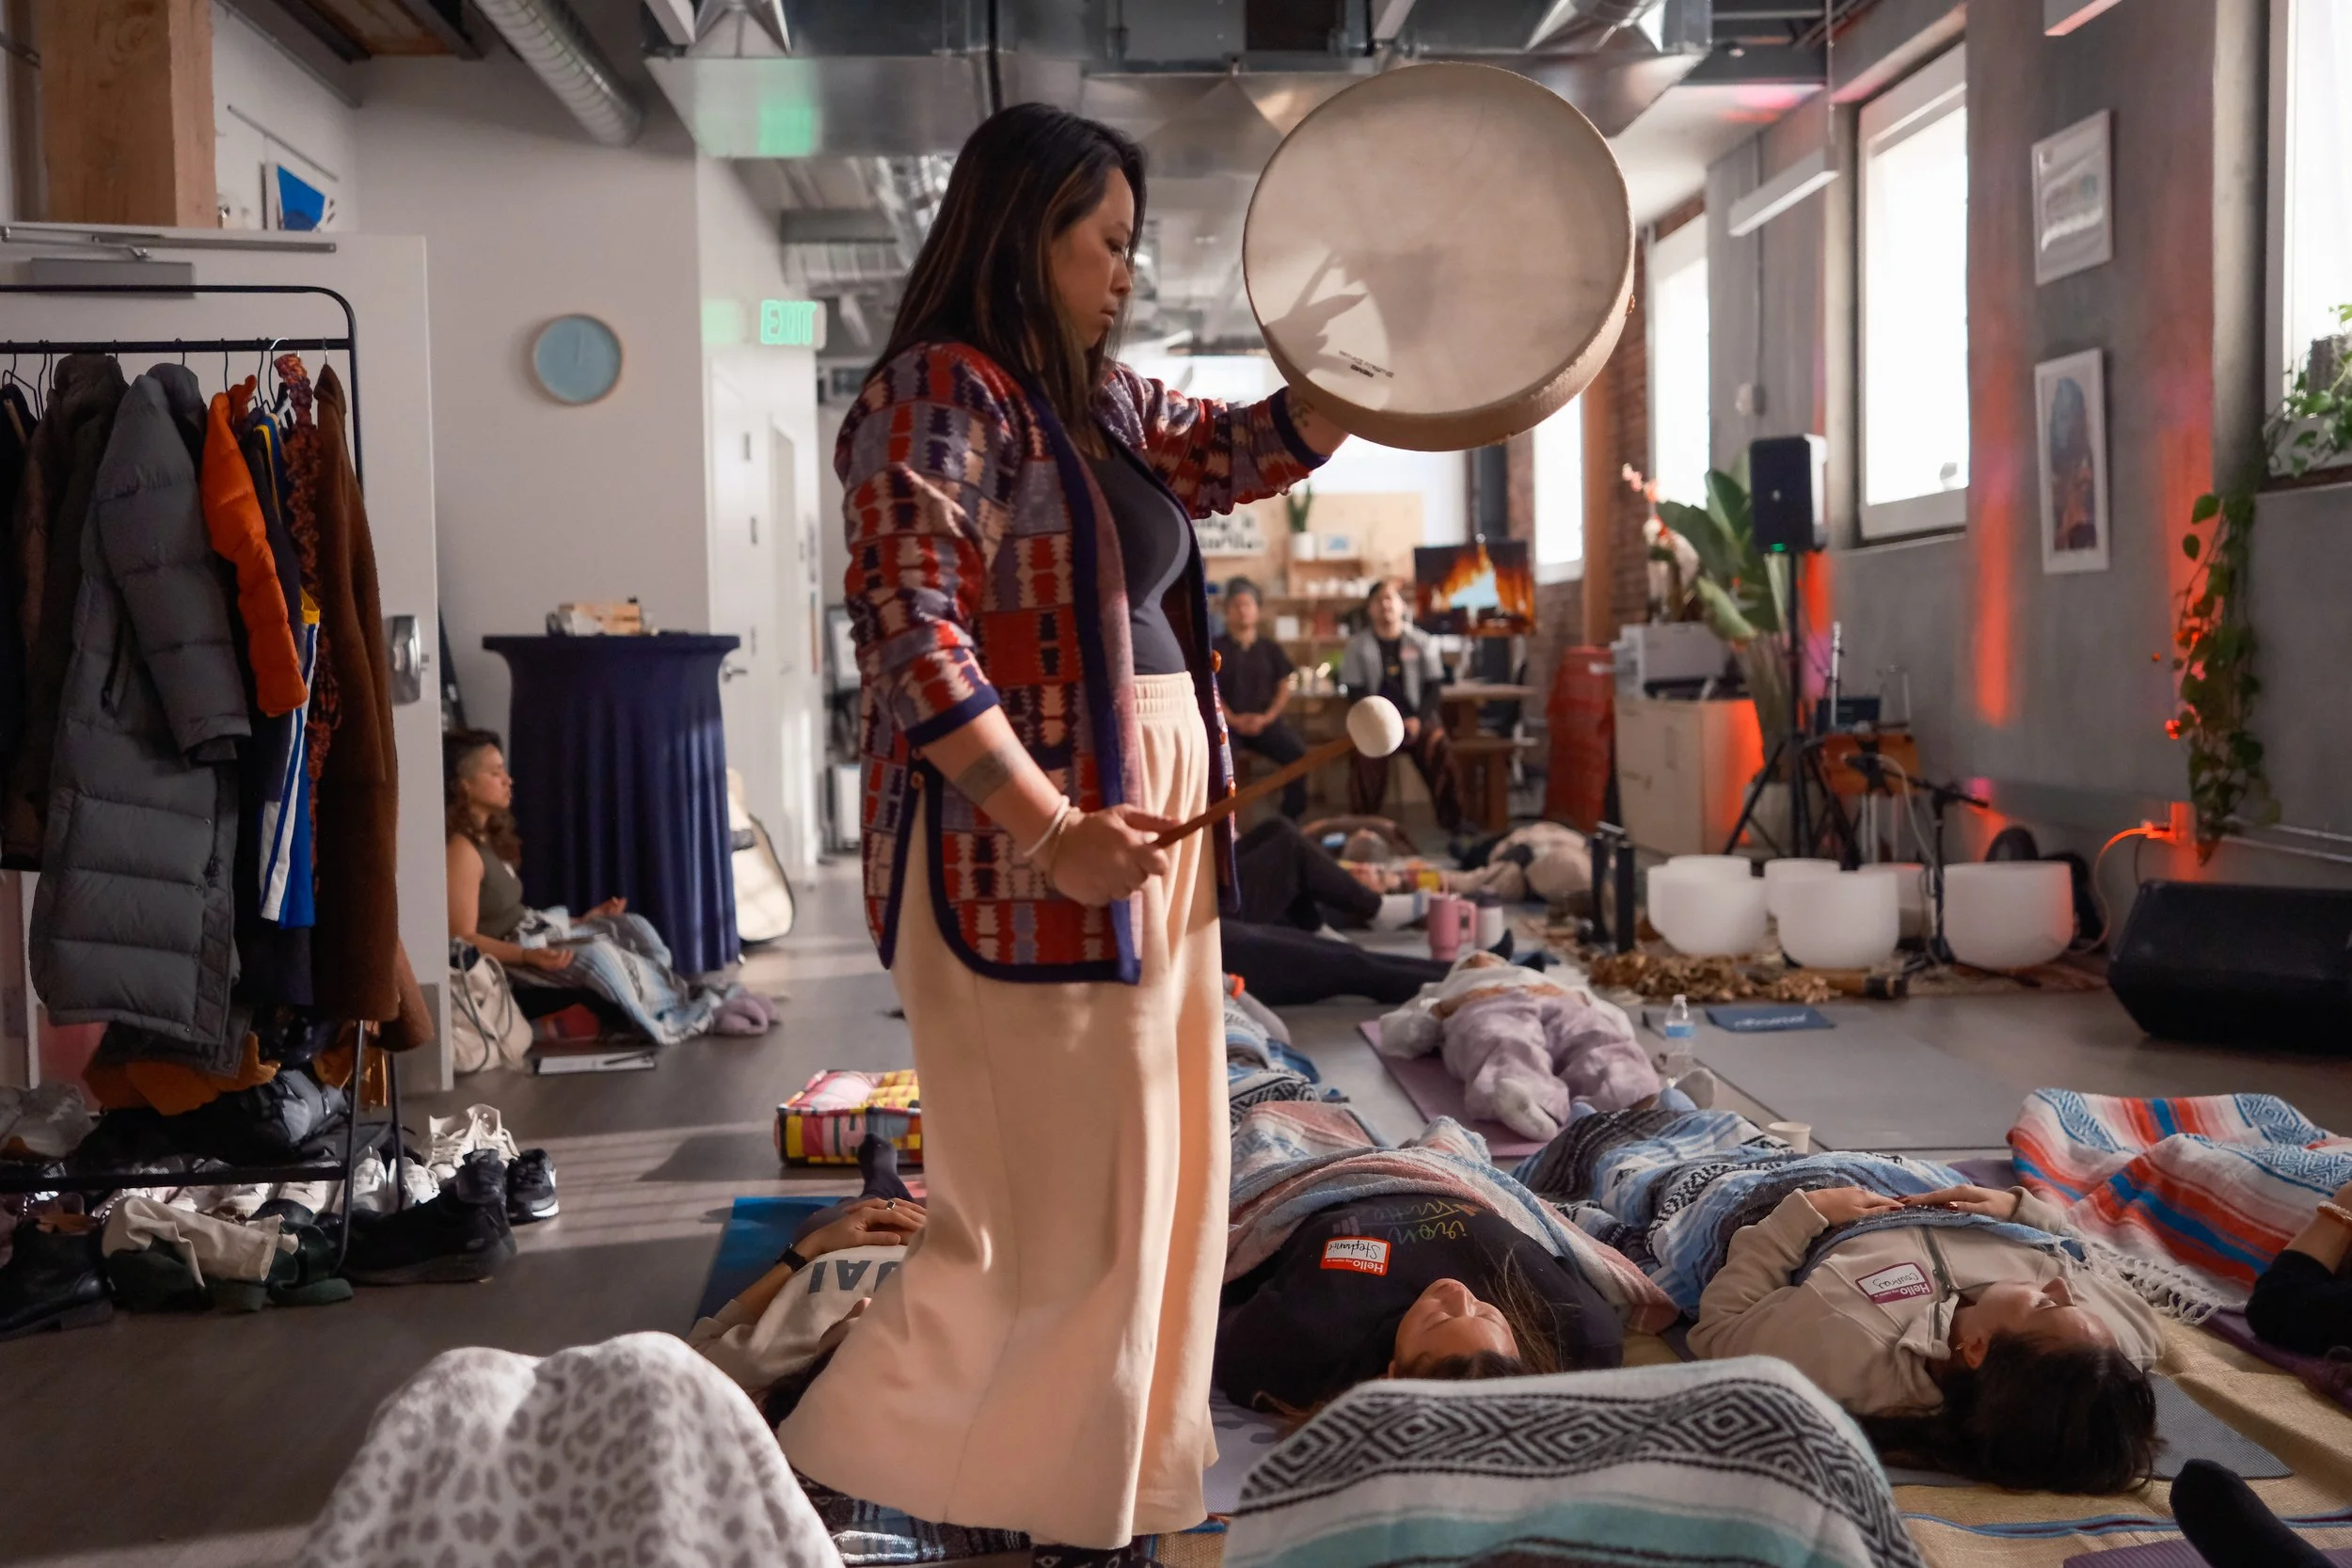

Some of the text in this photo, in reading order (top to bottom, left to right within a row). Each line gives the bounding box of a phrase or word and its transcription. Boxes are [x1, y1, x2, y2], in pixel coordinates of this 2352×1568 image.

[760, 299, 818, 346] EXIT
[1327, 1240, 1380, 1259] Stephanie
[1353, 1260, 1384, 1274] Hello
[1899, 1283, 1931, 1295] Hello
